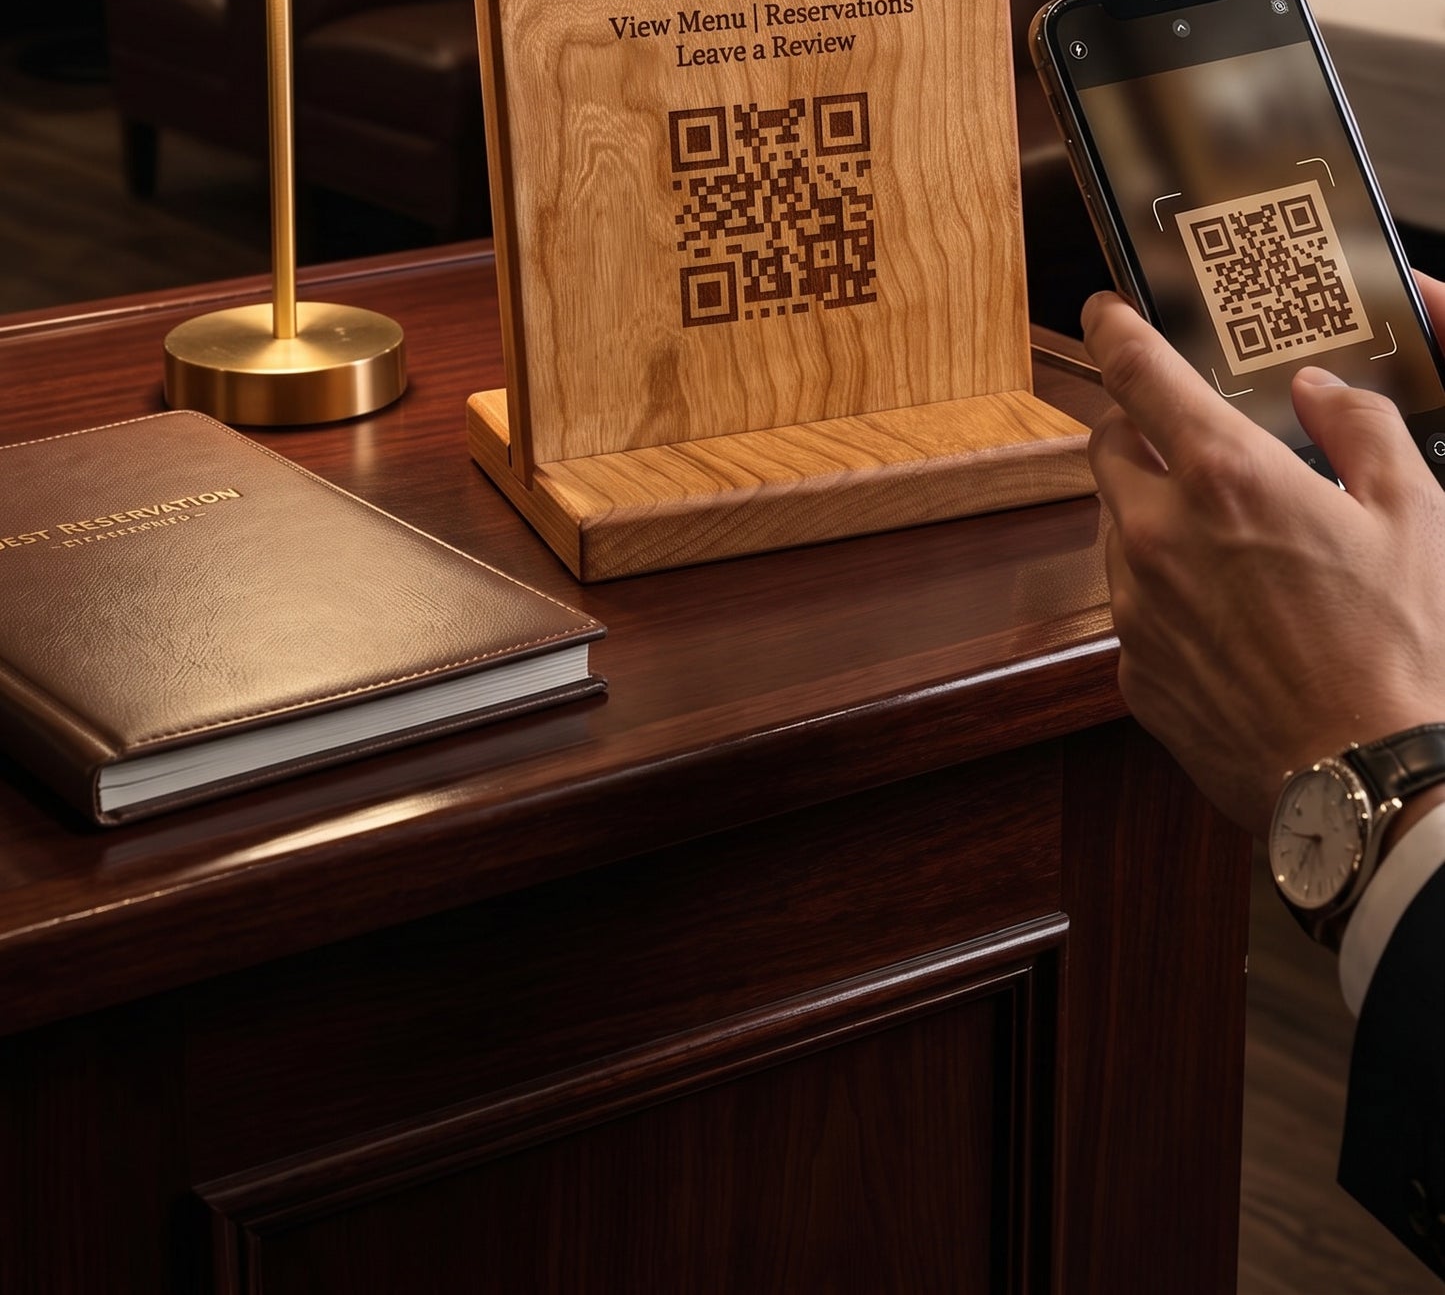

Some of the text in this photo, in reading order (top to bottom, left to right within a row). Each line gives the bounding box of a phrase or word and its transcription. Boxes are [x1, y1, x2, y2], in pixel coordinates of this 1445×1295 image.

[609, 16, 671, 40] View
[677, 9, 747, 34] Menu
[676, 32, 857, 67] Leave a Review
[56, 488, 242, 535] RESERVATION
